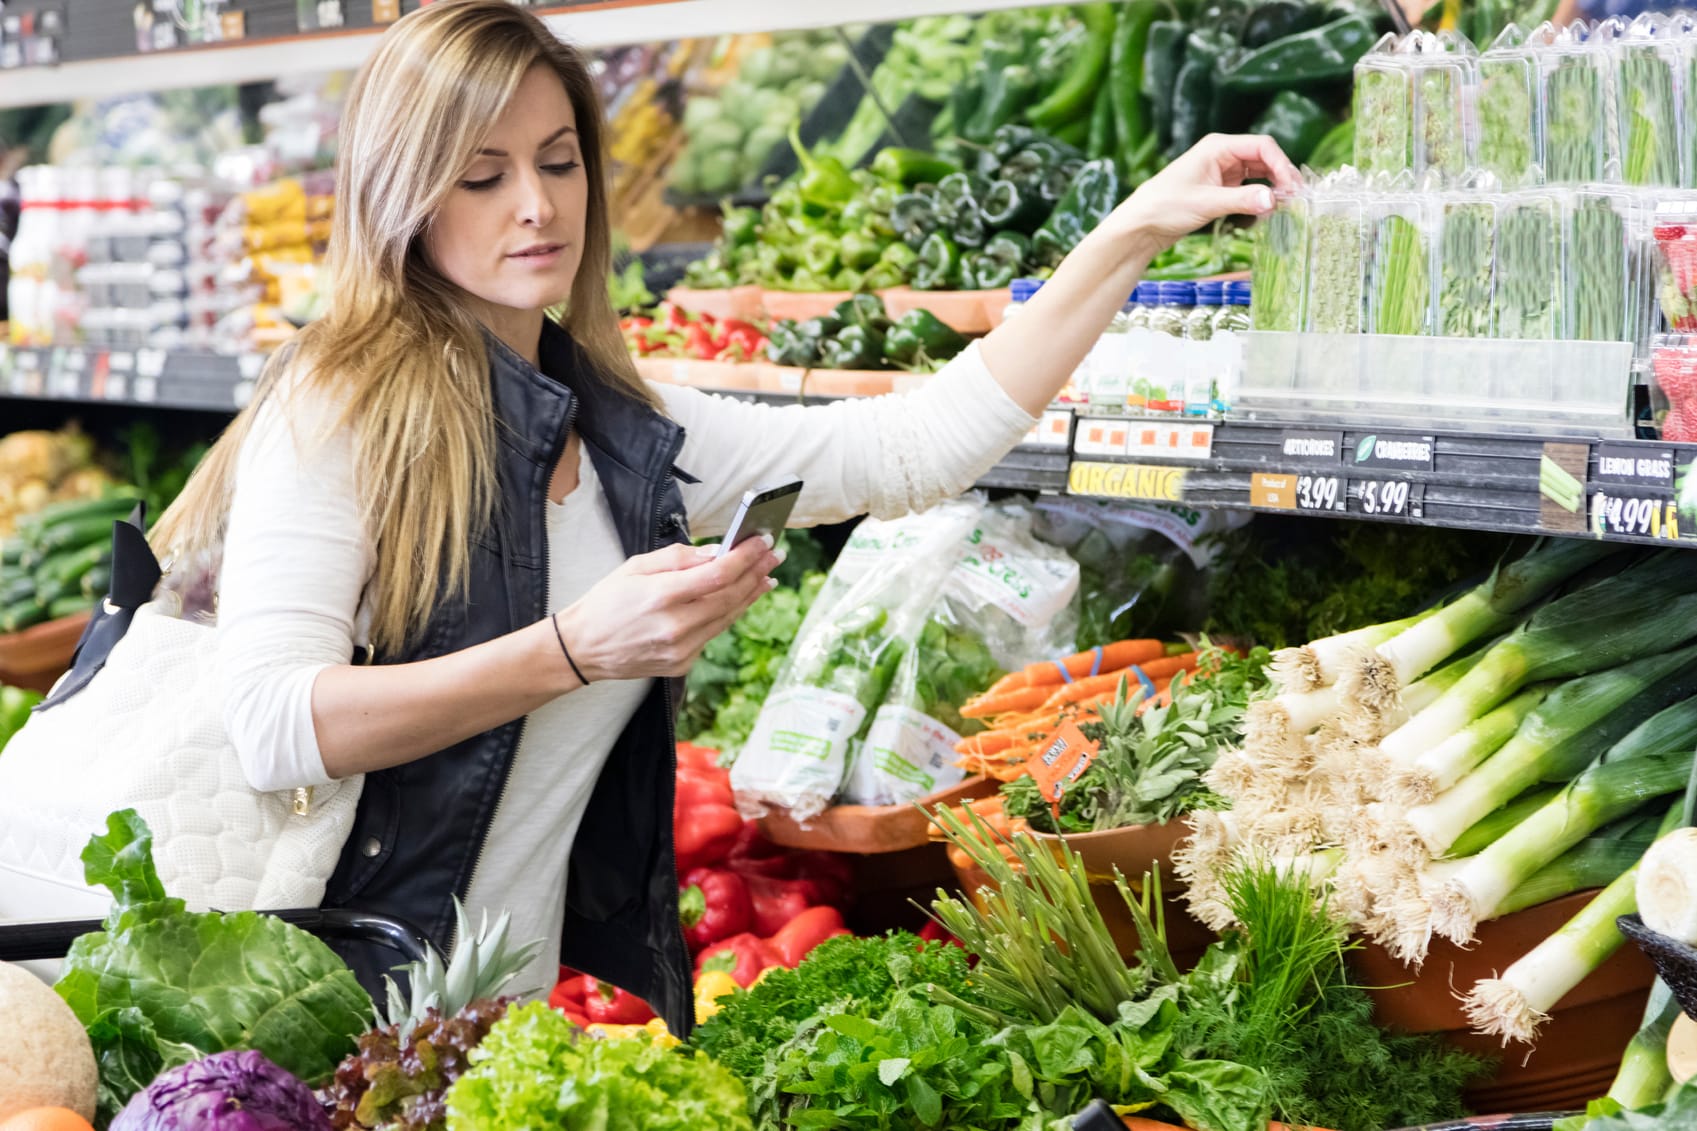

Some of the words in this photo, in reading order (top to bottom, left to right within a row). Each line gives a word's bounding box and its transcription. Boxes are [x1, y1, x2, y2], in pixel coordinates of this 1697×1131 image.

[1070, 463, 1182, 500] ORGANIC
[1599, 456, 1635, 475] LEMON
[1636, 458, 1671, 478] GRASS
[1297, 476, 1338, 509] $3.99
[1358, 481, 1408, 513] $5.99
